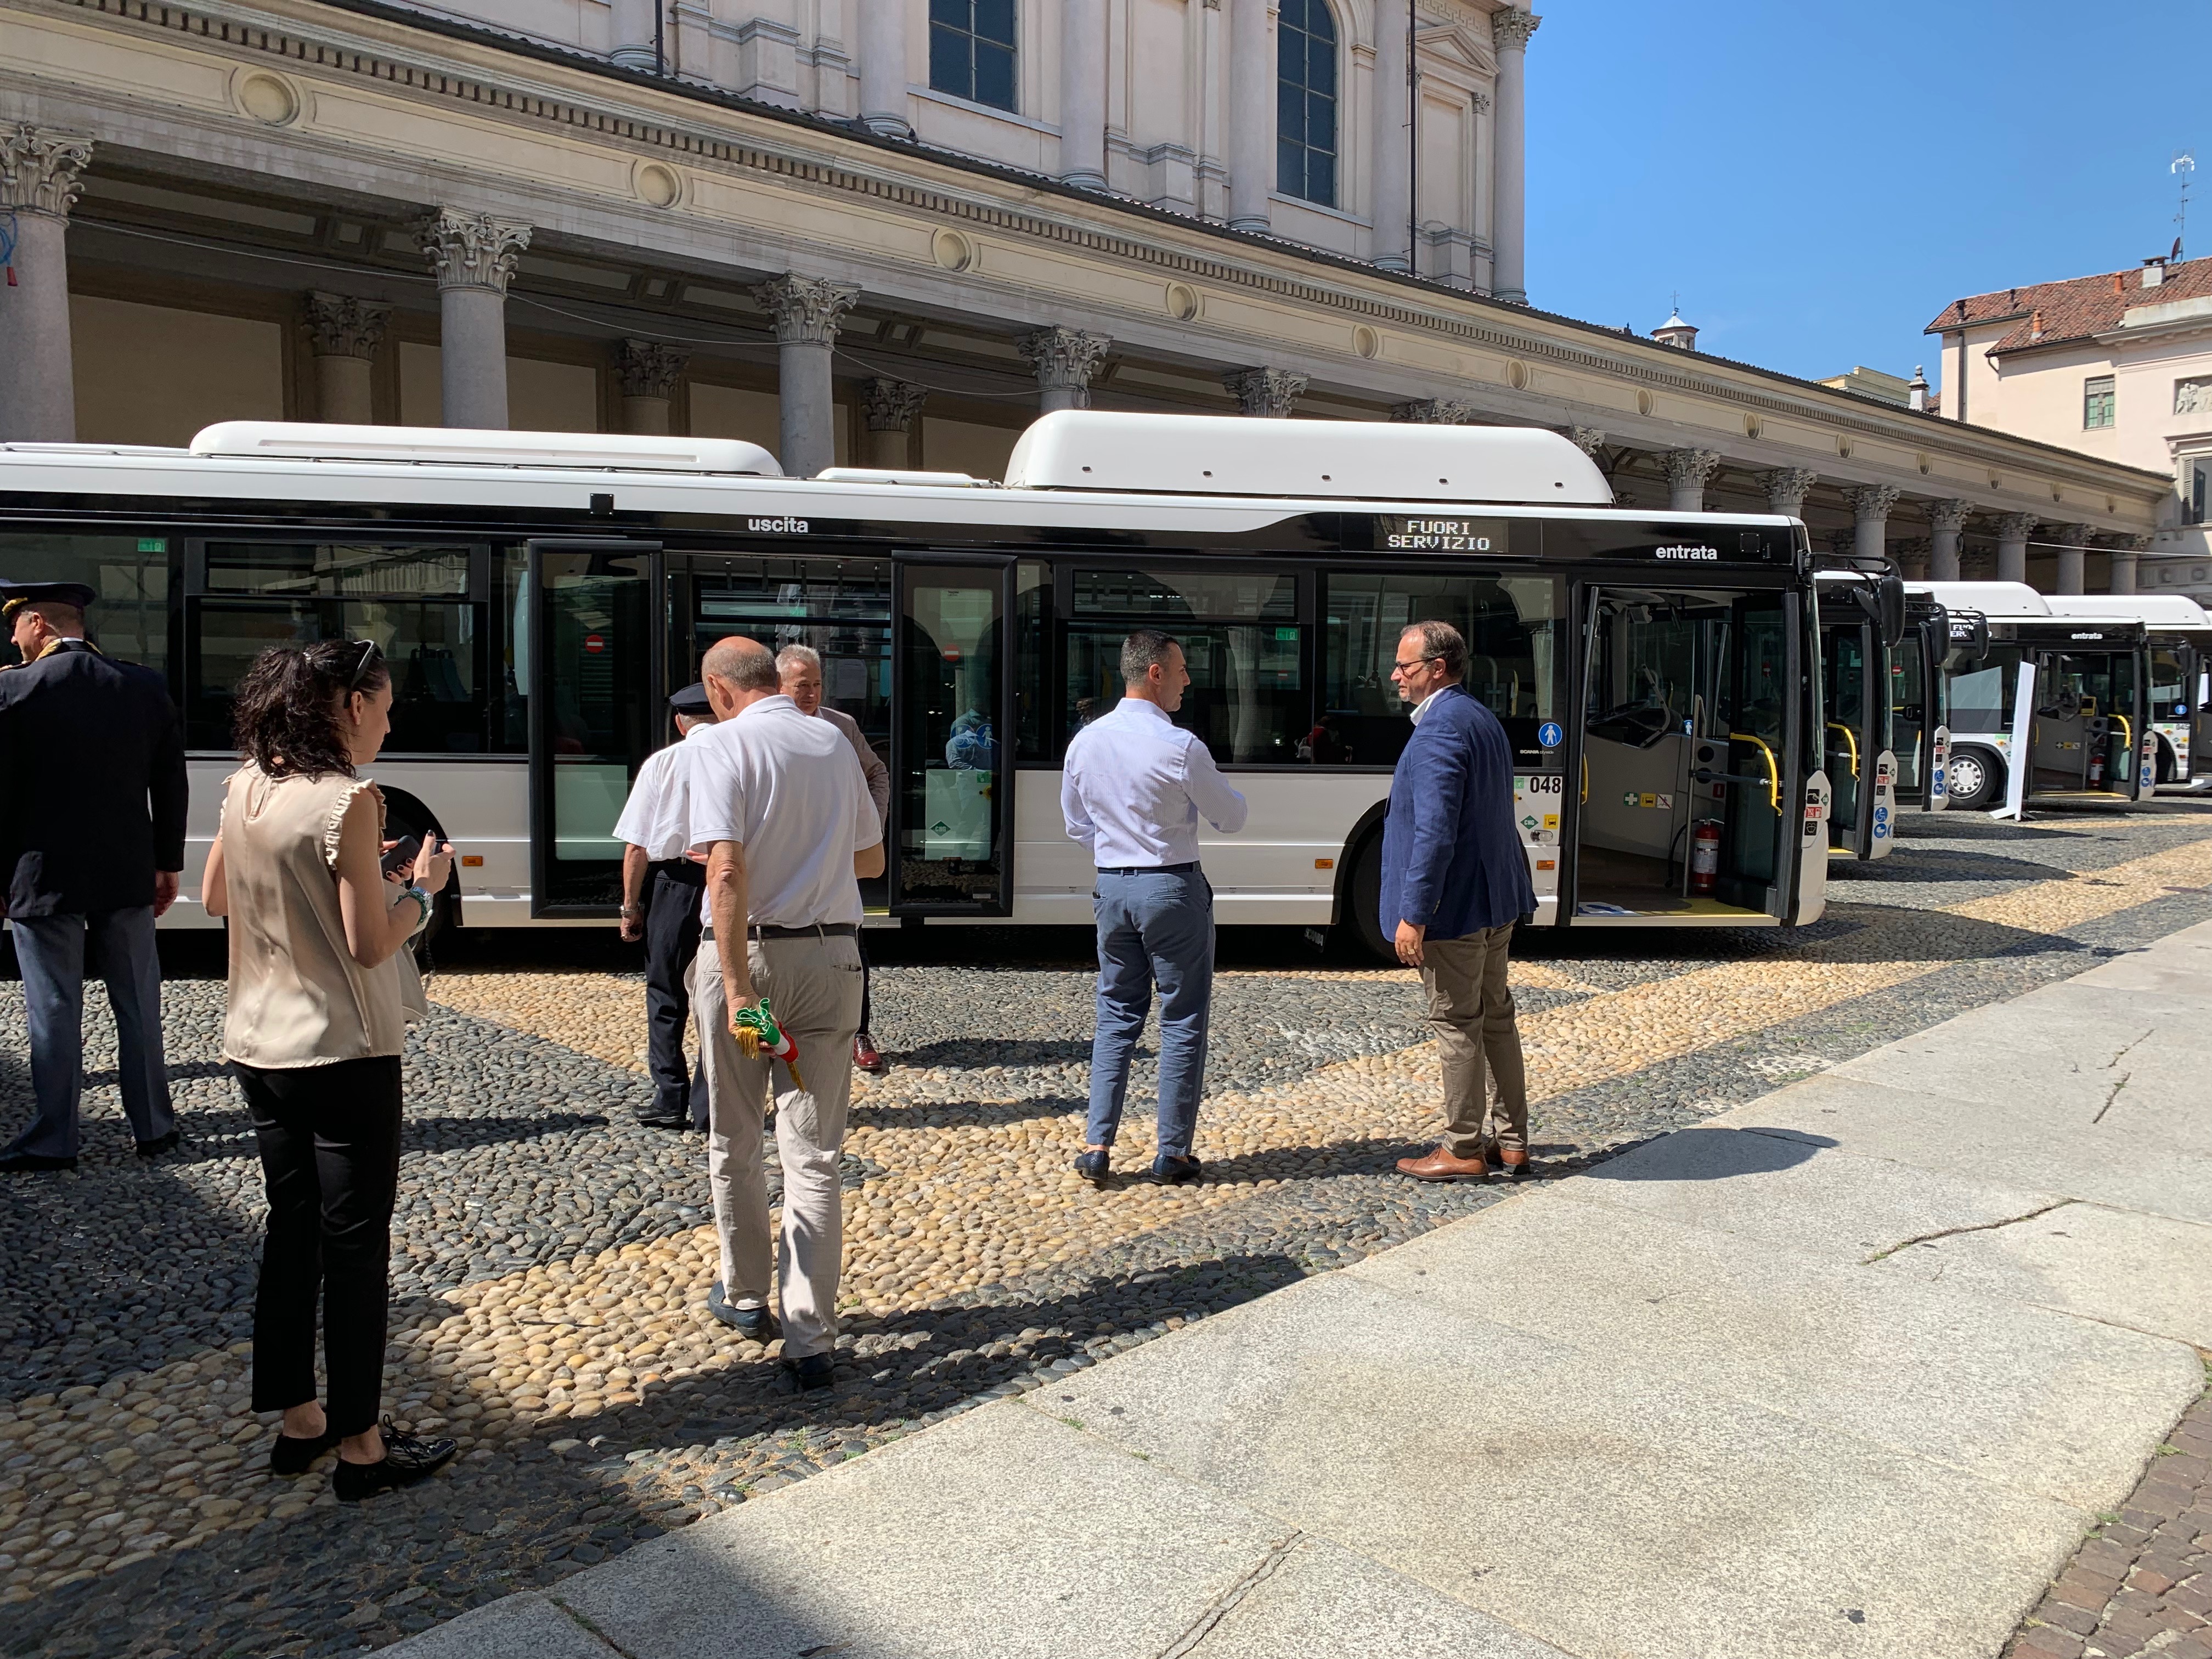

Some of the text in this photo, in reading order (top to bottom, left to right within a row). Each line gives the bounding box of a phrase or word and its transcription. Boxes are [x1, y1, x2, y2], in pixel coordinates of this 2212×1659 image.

[748, 516, 808, 533] uscita
[1408, 521, 1470, 534] FUORI
[1388, 535, 1489, 550] SERVIZIO
[1656, 545, 1718, 560] entrata
[1530, 776, 1561, 794] 048
